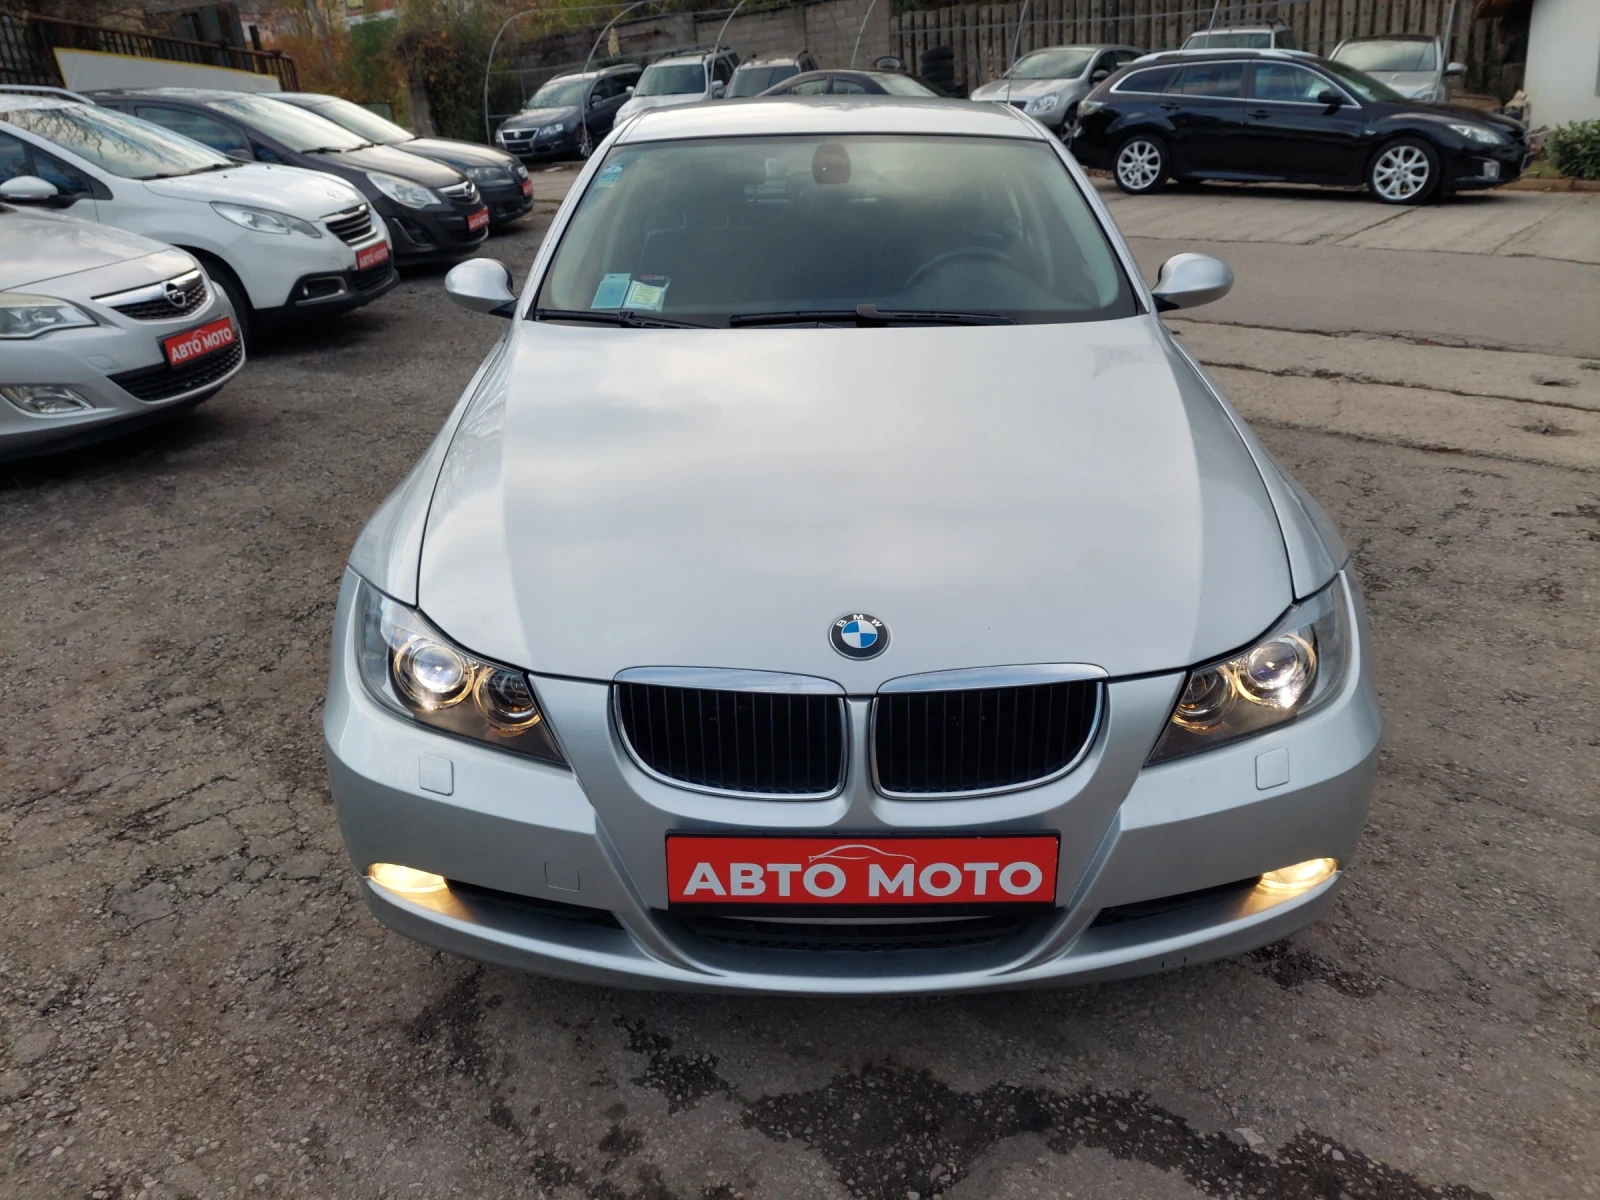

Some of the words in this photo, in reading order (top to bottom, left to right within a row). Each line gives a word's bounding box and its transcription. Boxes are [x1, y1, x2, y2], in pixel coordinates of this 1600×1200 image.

[171, 339, 202, 362] АВТО
[202, 327, 232, 350] МОТО
[836, 614, 882, 628] BMW
[682, 861, 847, 898] АВТО
[868, 861, 1043, 897] МОТО
